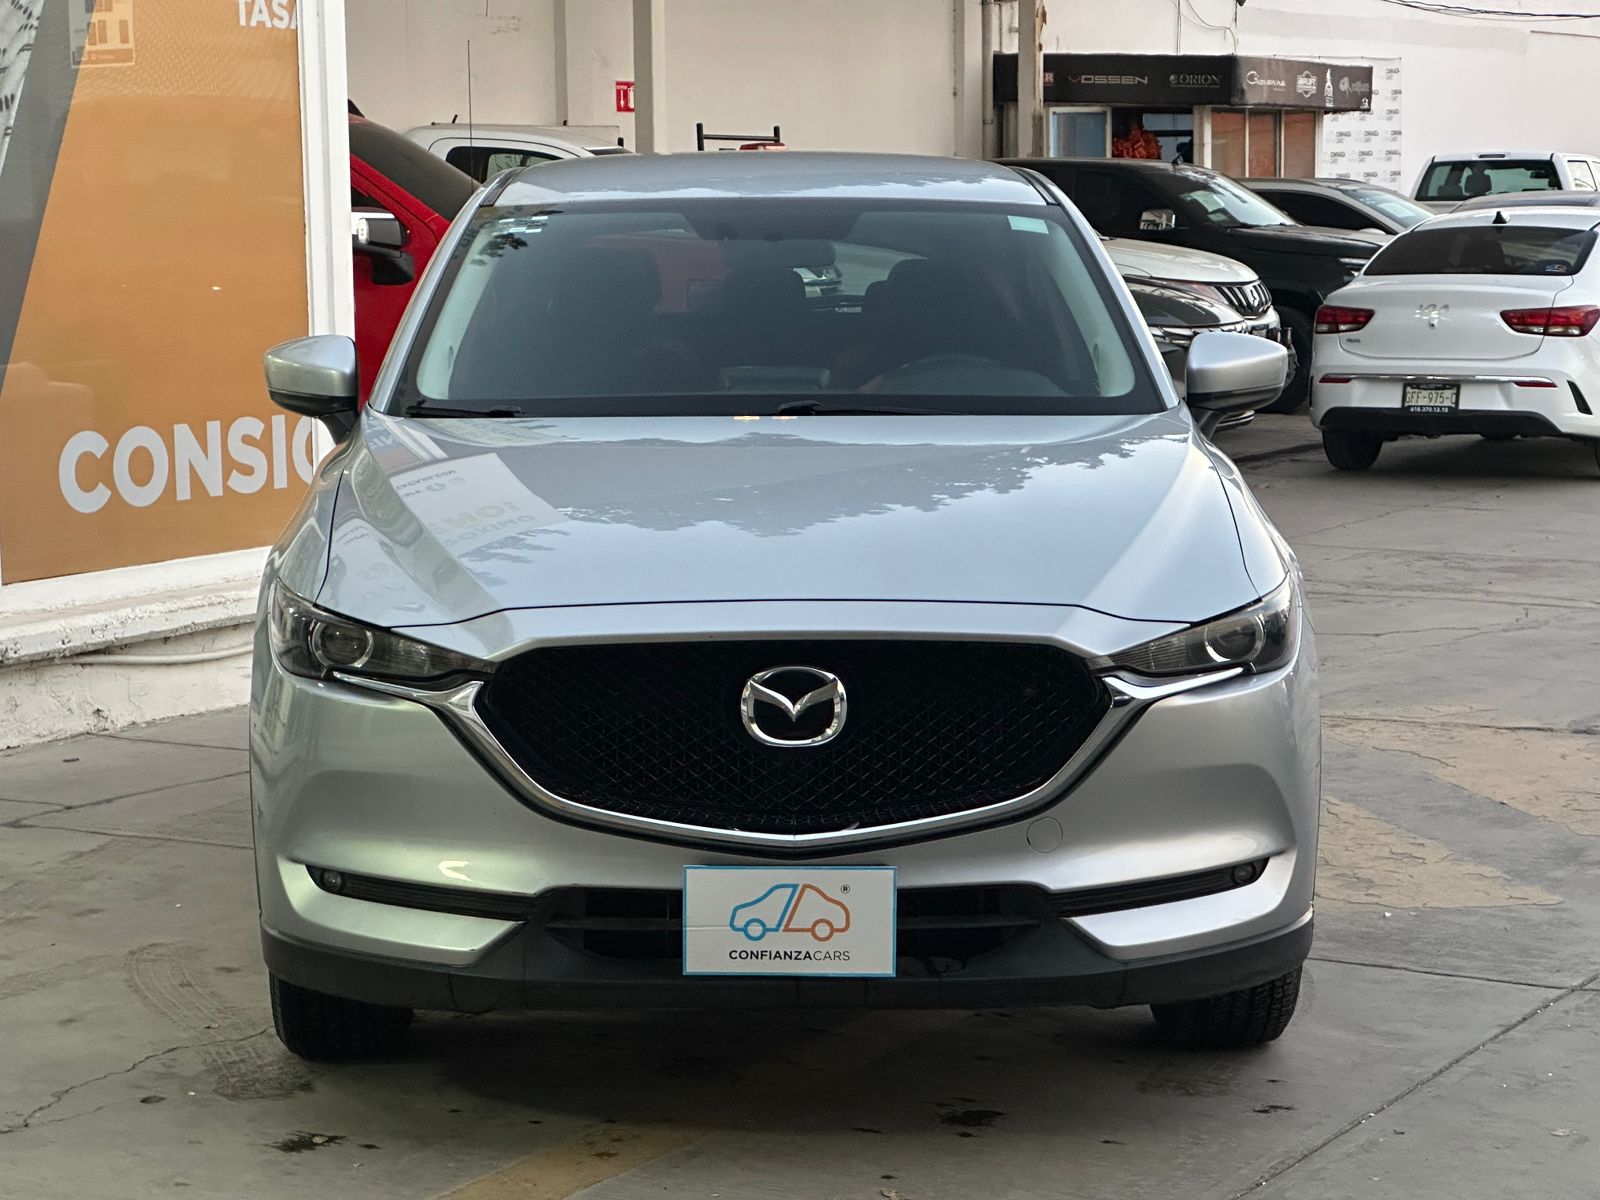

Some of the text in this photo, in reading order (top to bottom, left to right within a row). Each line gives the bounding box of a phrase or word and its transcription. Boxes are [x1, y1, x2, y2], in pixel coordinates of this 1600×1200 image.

[239, 0, 296, 29] TAS
[1067, 74, 1148, 85] VOSSEN
[1179, 73, 1220, 85] ORION
[728, 949, 851, 962] CONFIANZACARS
